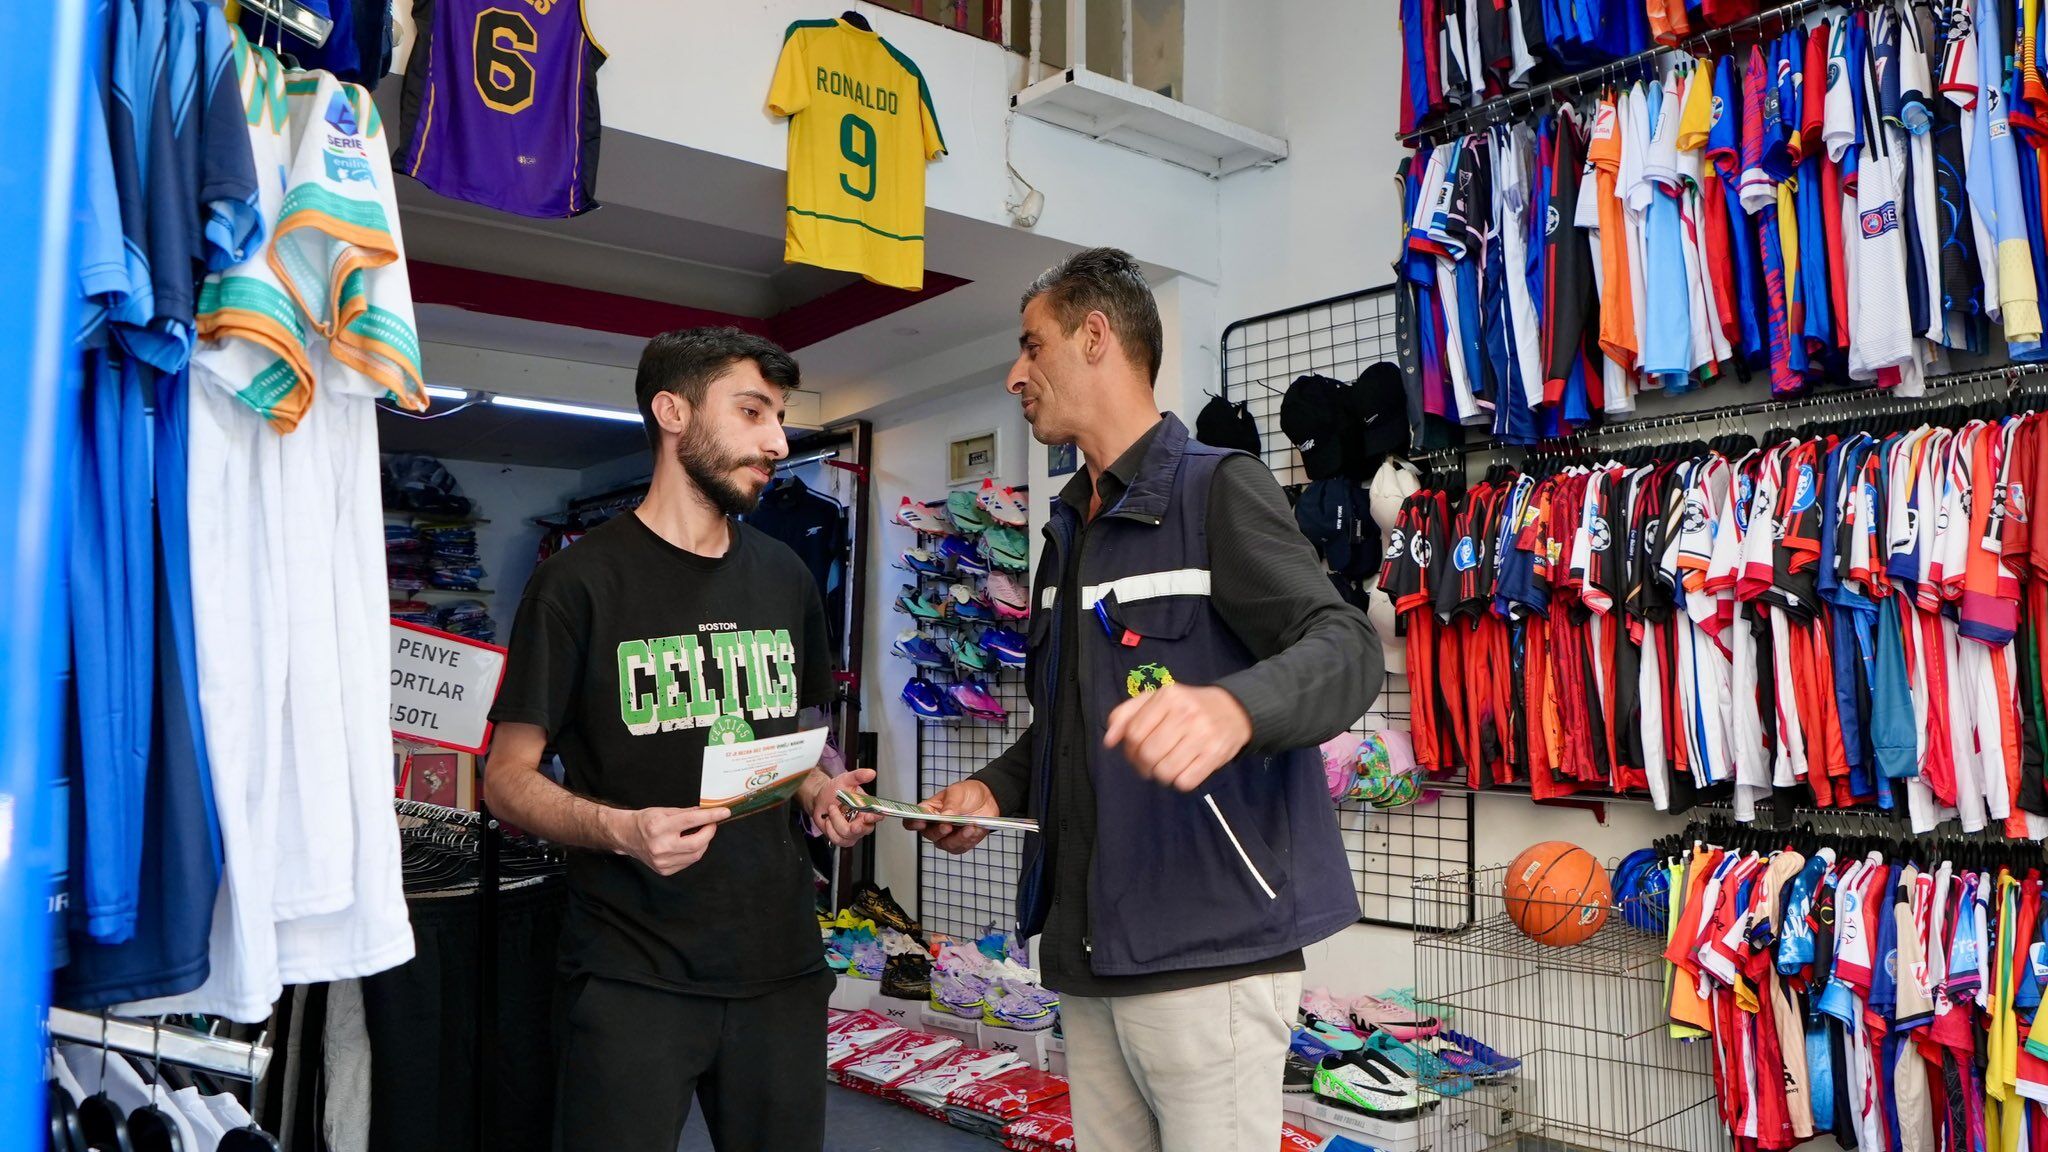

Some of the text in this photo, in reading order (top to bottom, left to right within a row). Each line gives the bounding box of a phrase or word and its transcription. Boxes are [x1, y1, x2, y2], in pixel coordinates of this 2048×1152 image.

[473, 7, 538, 115] 6
[816, 66, 899, 115] RONALDO
[327, 134, 364, 150] SERIE
[840, 113, 877, 202] 9
[698, 622, 738, 632] BOSTON
[397, 637, 461, 668] PENYE
[391, 669, 465, 701] ORTLAR
[617, 629, 798, 736] CELTICS
[711, 718, 750, 741] CELTICS
